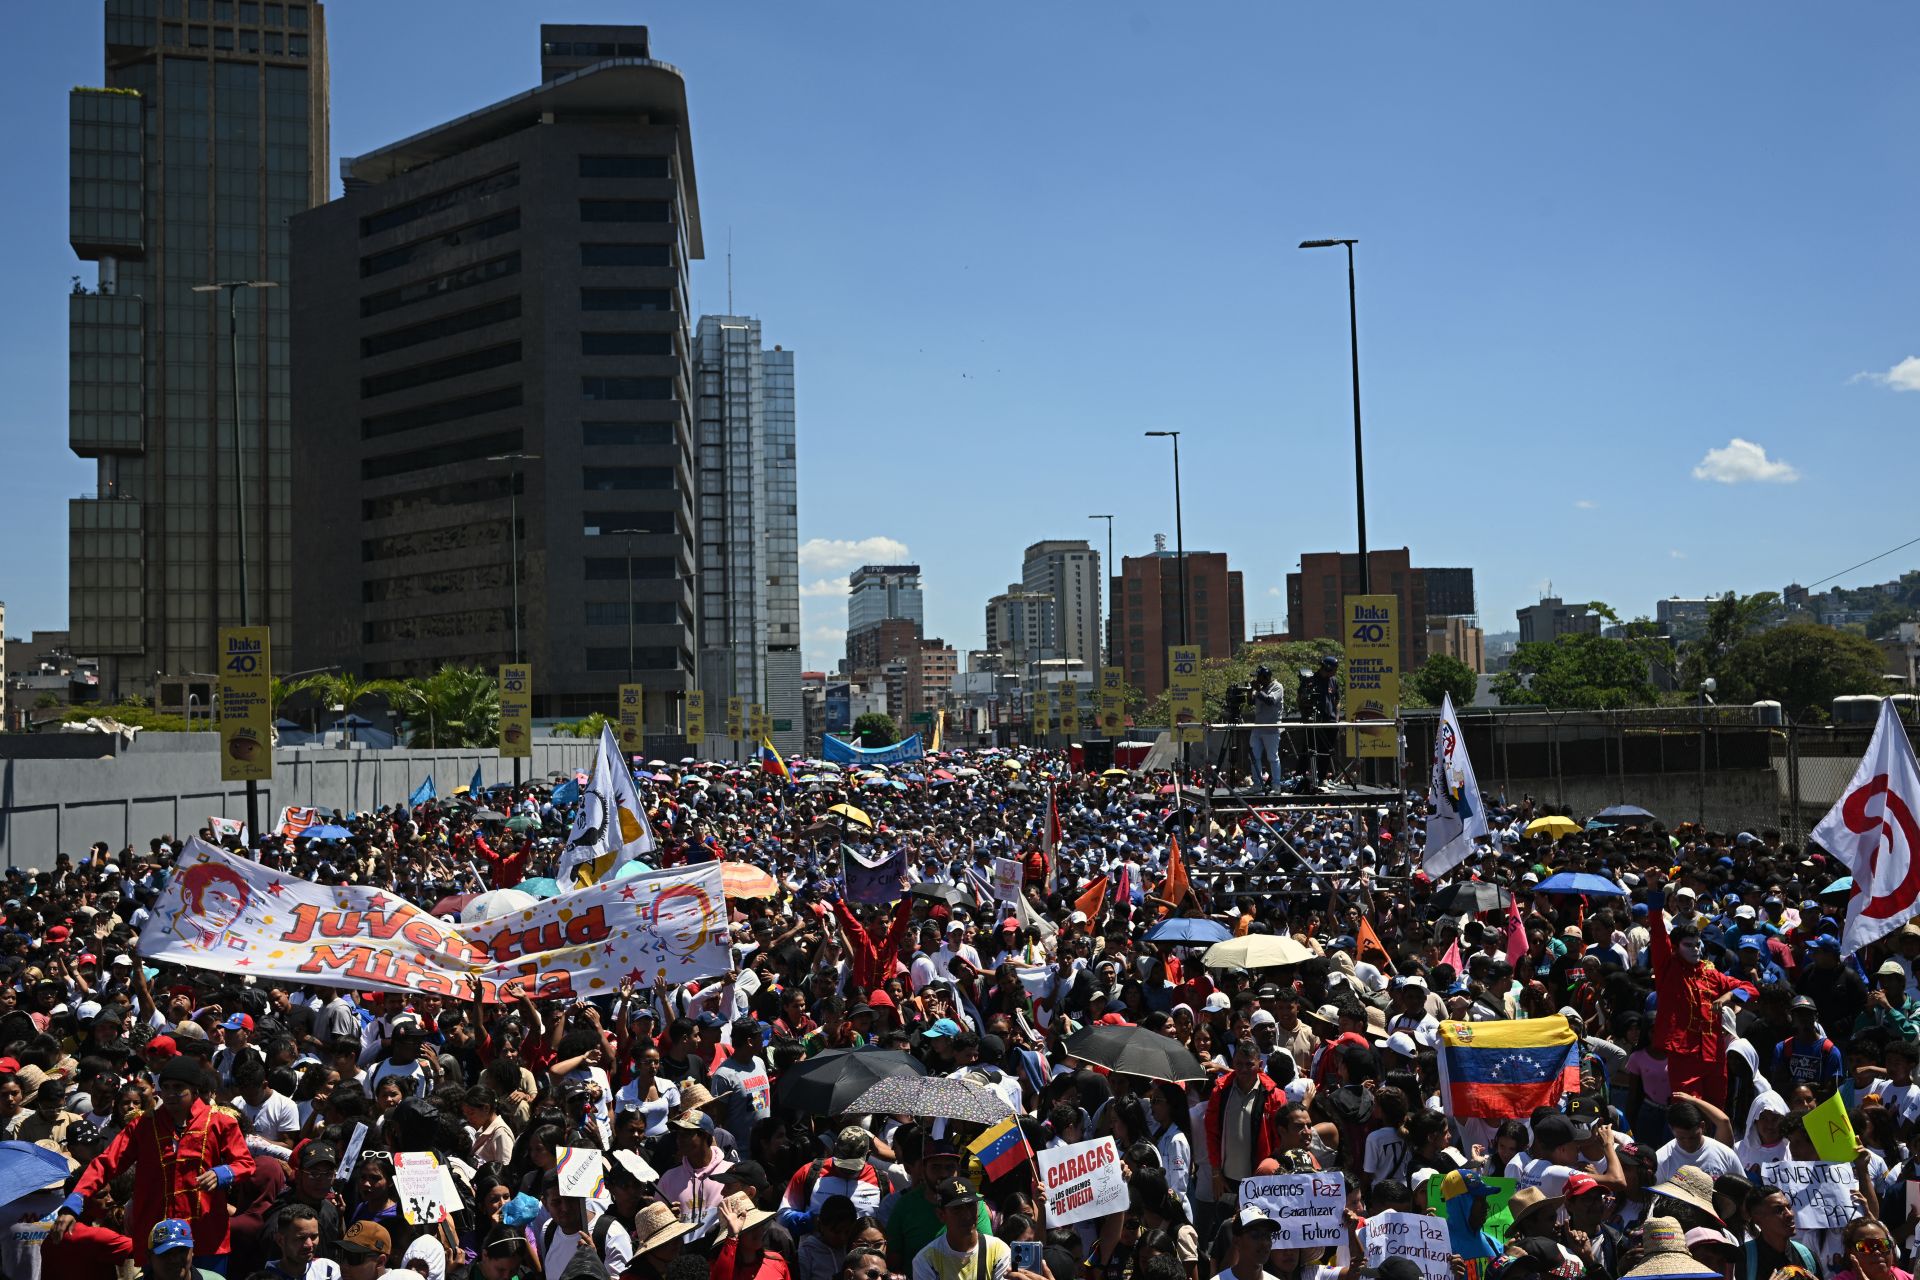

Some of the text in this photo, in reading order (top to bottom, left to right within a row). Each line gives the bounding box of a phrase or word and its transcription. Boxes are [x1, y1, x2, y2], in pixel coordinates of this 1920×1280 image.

[1355, 605, 1388, 619] Daka
[1353, 625, 1383, 642] 40
[229, 637, 261, 651] Daka
[227, 656, 257, 672] 40
[1174, 663, 1192, 673] 40
[504, 681, 522, 691] 40
[296, 945, 577, 1004] Miranda
[1790, 1066, 1816, 1079] VANS
[1572, 1101, 1579, 1112] P
[1047, 1142, 1114, 1189] CARACAS
[952, 1181, 968, 1194] LA
[1055, 1190, 1065, 1200] LOS
[1065, 1179, 1091, 1197] QUEREMOS
[1313, 1178, 1342, 1197] Paz
[1067, 1187, 1094, 1211] VUELTA
[1806, 1188, 1826, 1206] LA
[1279, 1200, 1337, 1218] Garantizar
[1420, 1220, 1445, 1241] Paz
